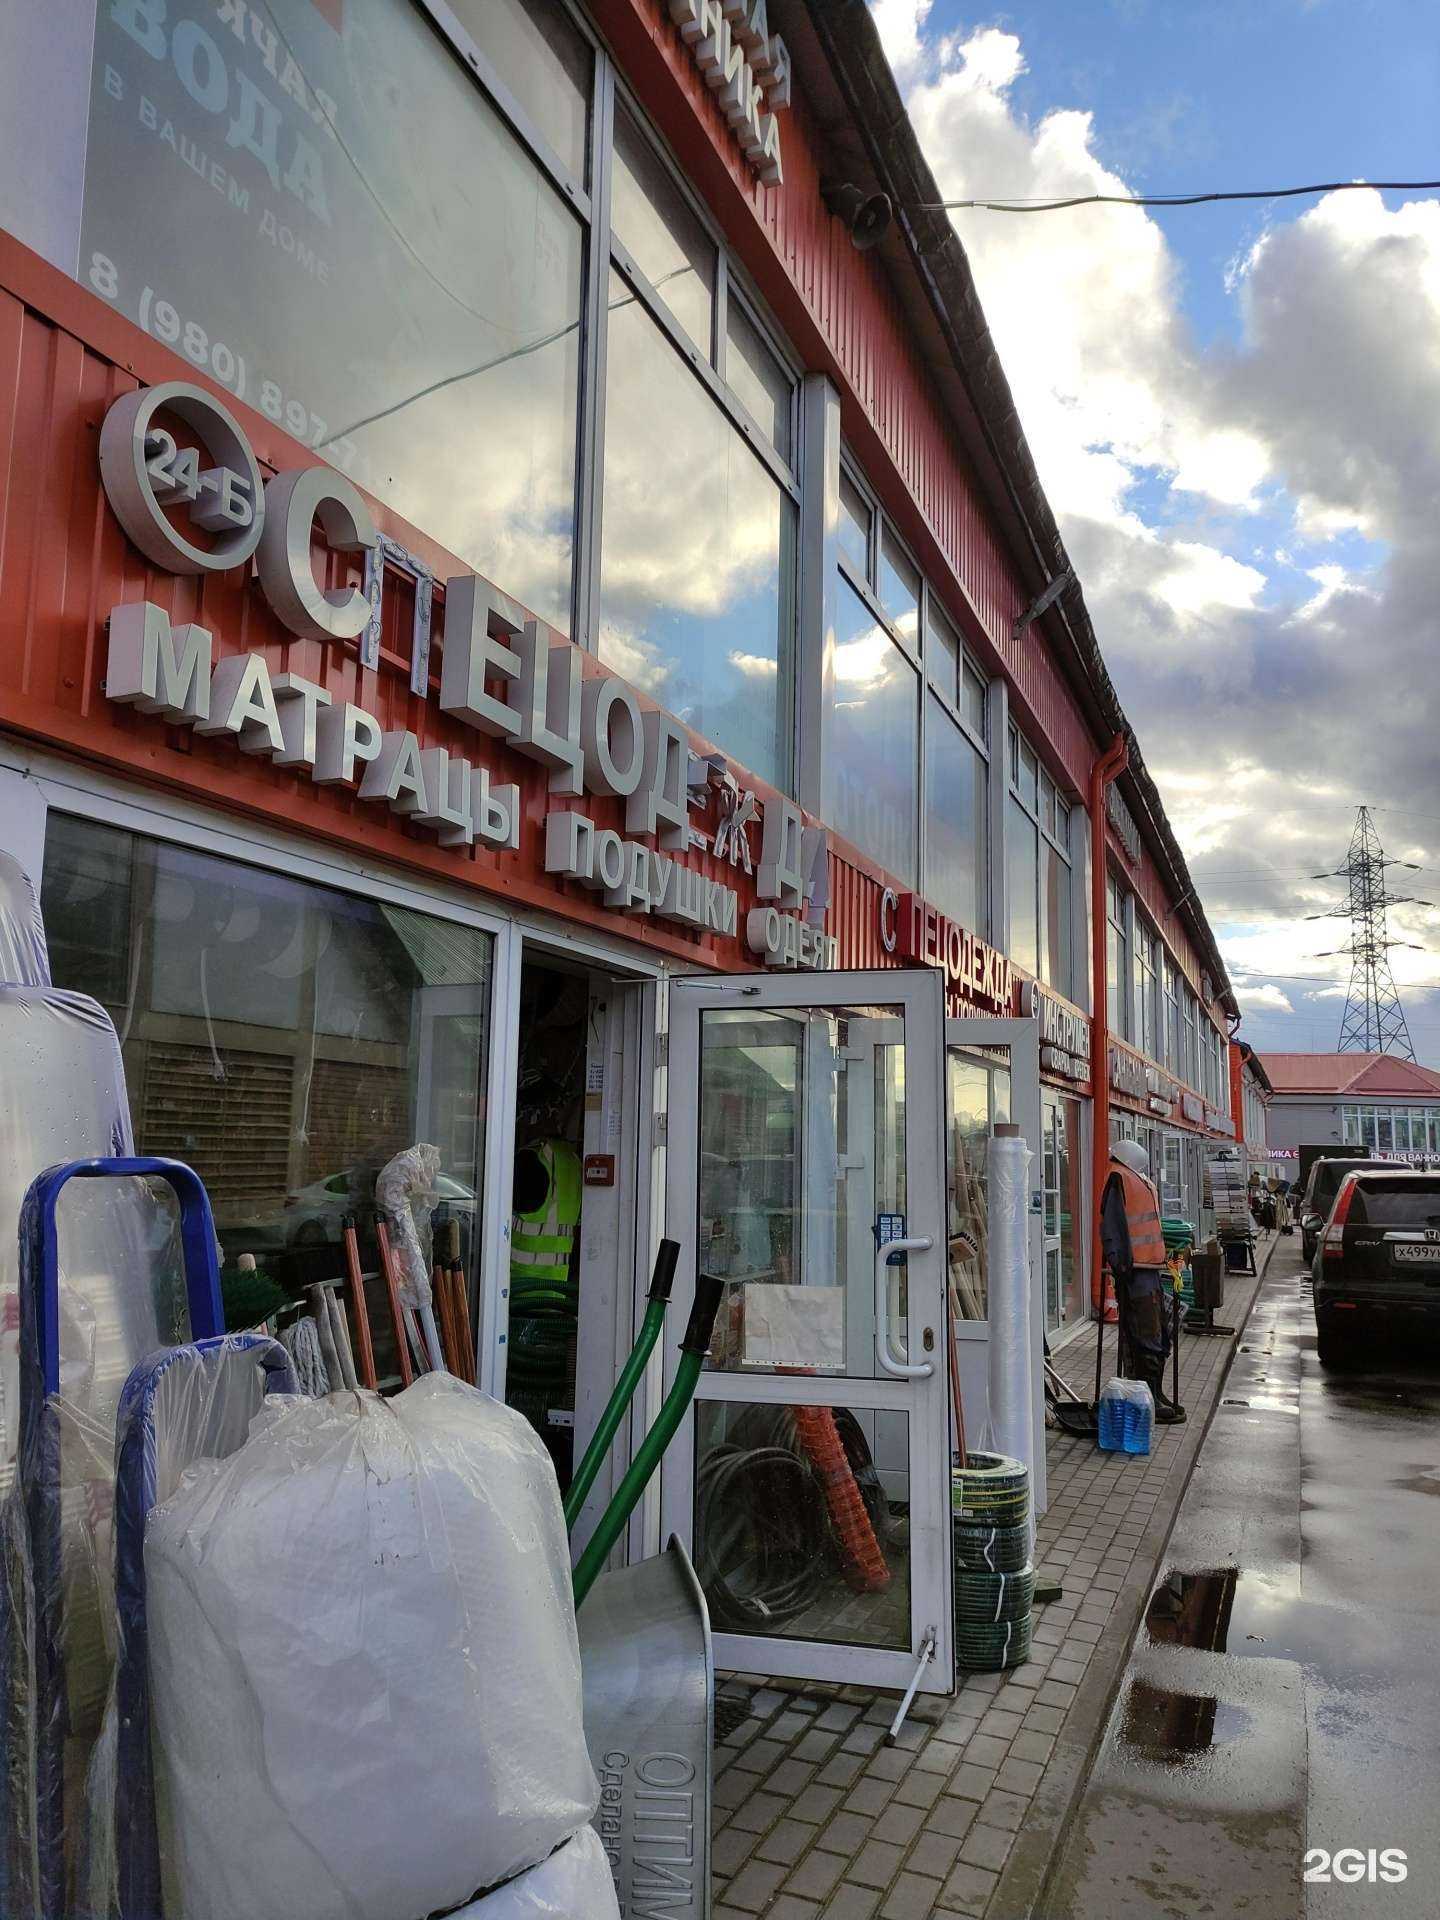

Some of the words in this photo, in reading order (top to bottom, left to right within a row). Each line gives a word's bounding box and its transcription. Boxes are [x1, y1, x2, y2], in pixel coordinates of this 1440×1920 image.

[104, 64, 124, 100] В
[139, 95, 250, 215] ВАШЕМ
[258, 208, 330, 286] ДОМЕ
[110, 0, 332, 228] ВОДА
[676, 0, 784, 188] НИКА
[88, 251, 118, 299] 8
[138, 285, 247, 400] (980)
[144, 428, 256, 532] 24-Б
[106, 601, 520, 850] МАТРАЦЫ
[545, 811, 738, 937] ПОДУШКИ
